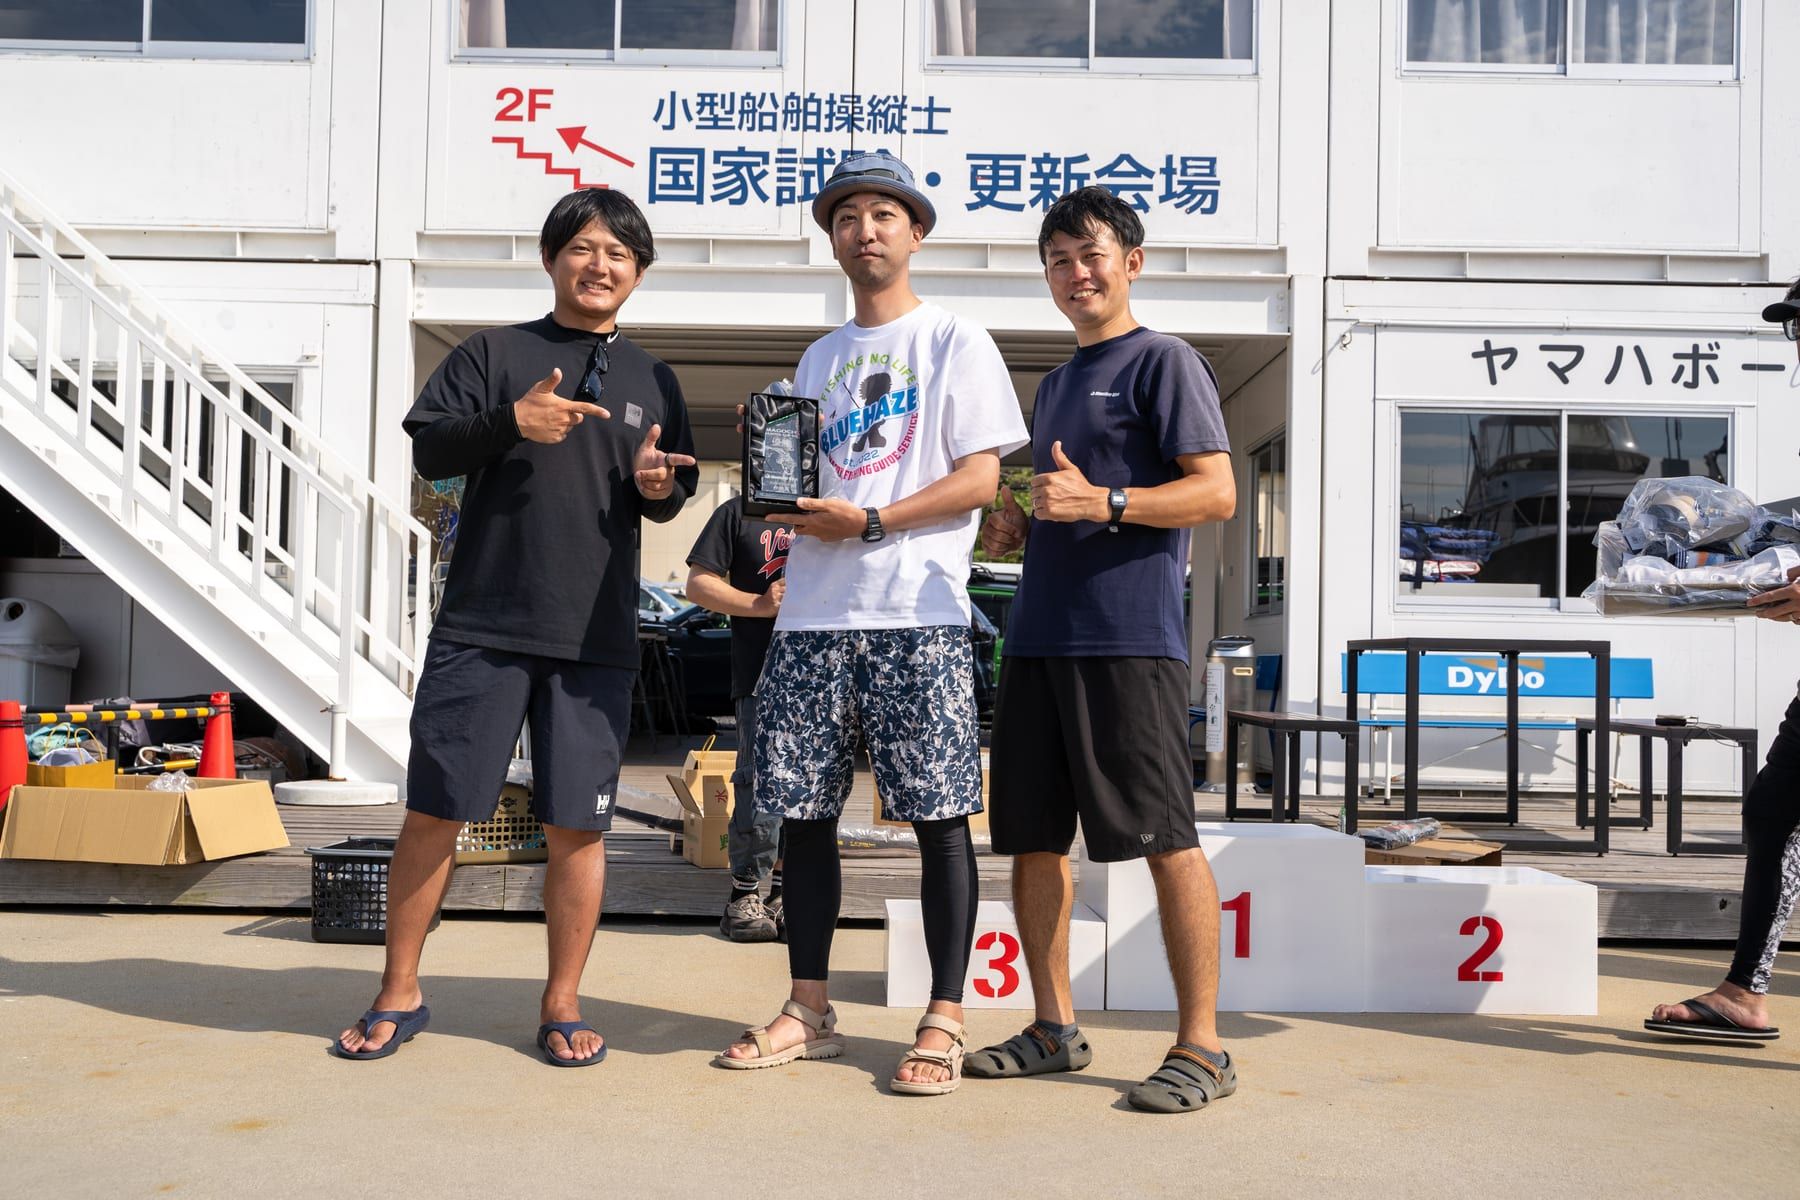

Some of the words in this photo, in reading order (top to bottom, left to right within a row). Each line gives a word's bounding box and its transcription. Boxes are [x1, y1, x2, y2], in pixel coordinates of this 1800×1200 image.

[495, 87, 554, 122] 2F
[653, 91, 951, 135] 小型船舶操縦士
[648, 146, 1221, 215] 国家試・更新会場
[820, 355, 864, 402] FISHING
[870, 353, 890, 365] NO
[892, 357, 917, 386] LIFE
[1472, 339, 1786, 389] ヤマハボー
[874, 450, 902, 472] GUIDE
[901, 412, 919, 455] SERVICE
[1448, 666, 1545, 694] DyDo
[1221, 892, 1251, 958] 1
[1457, 916, 1504, 982] 2
[973, 932, 1020, 998] 3
